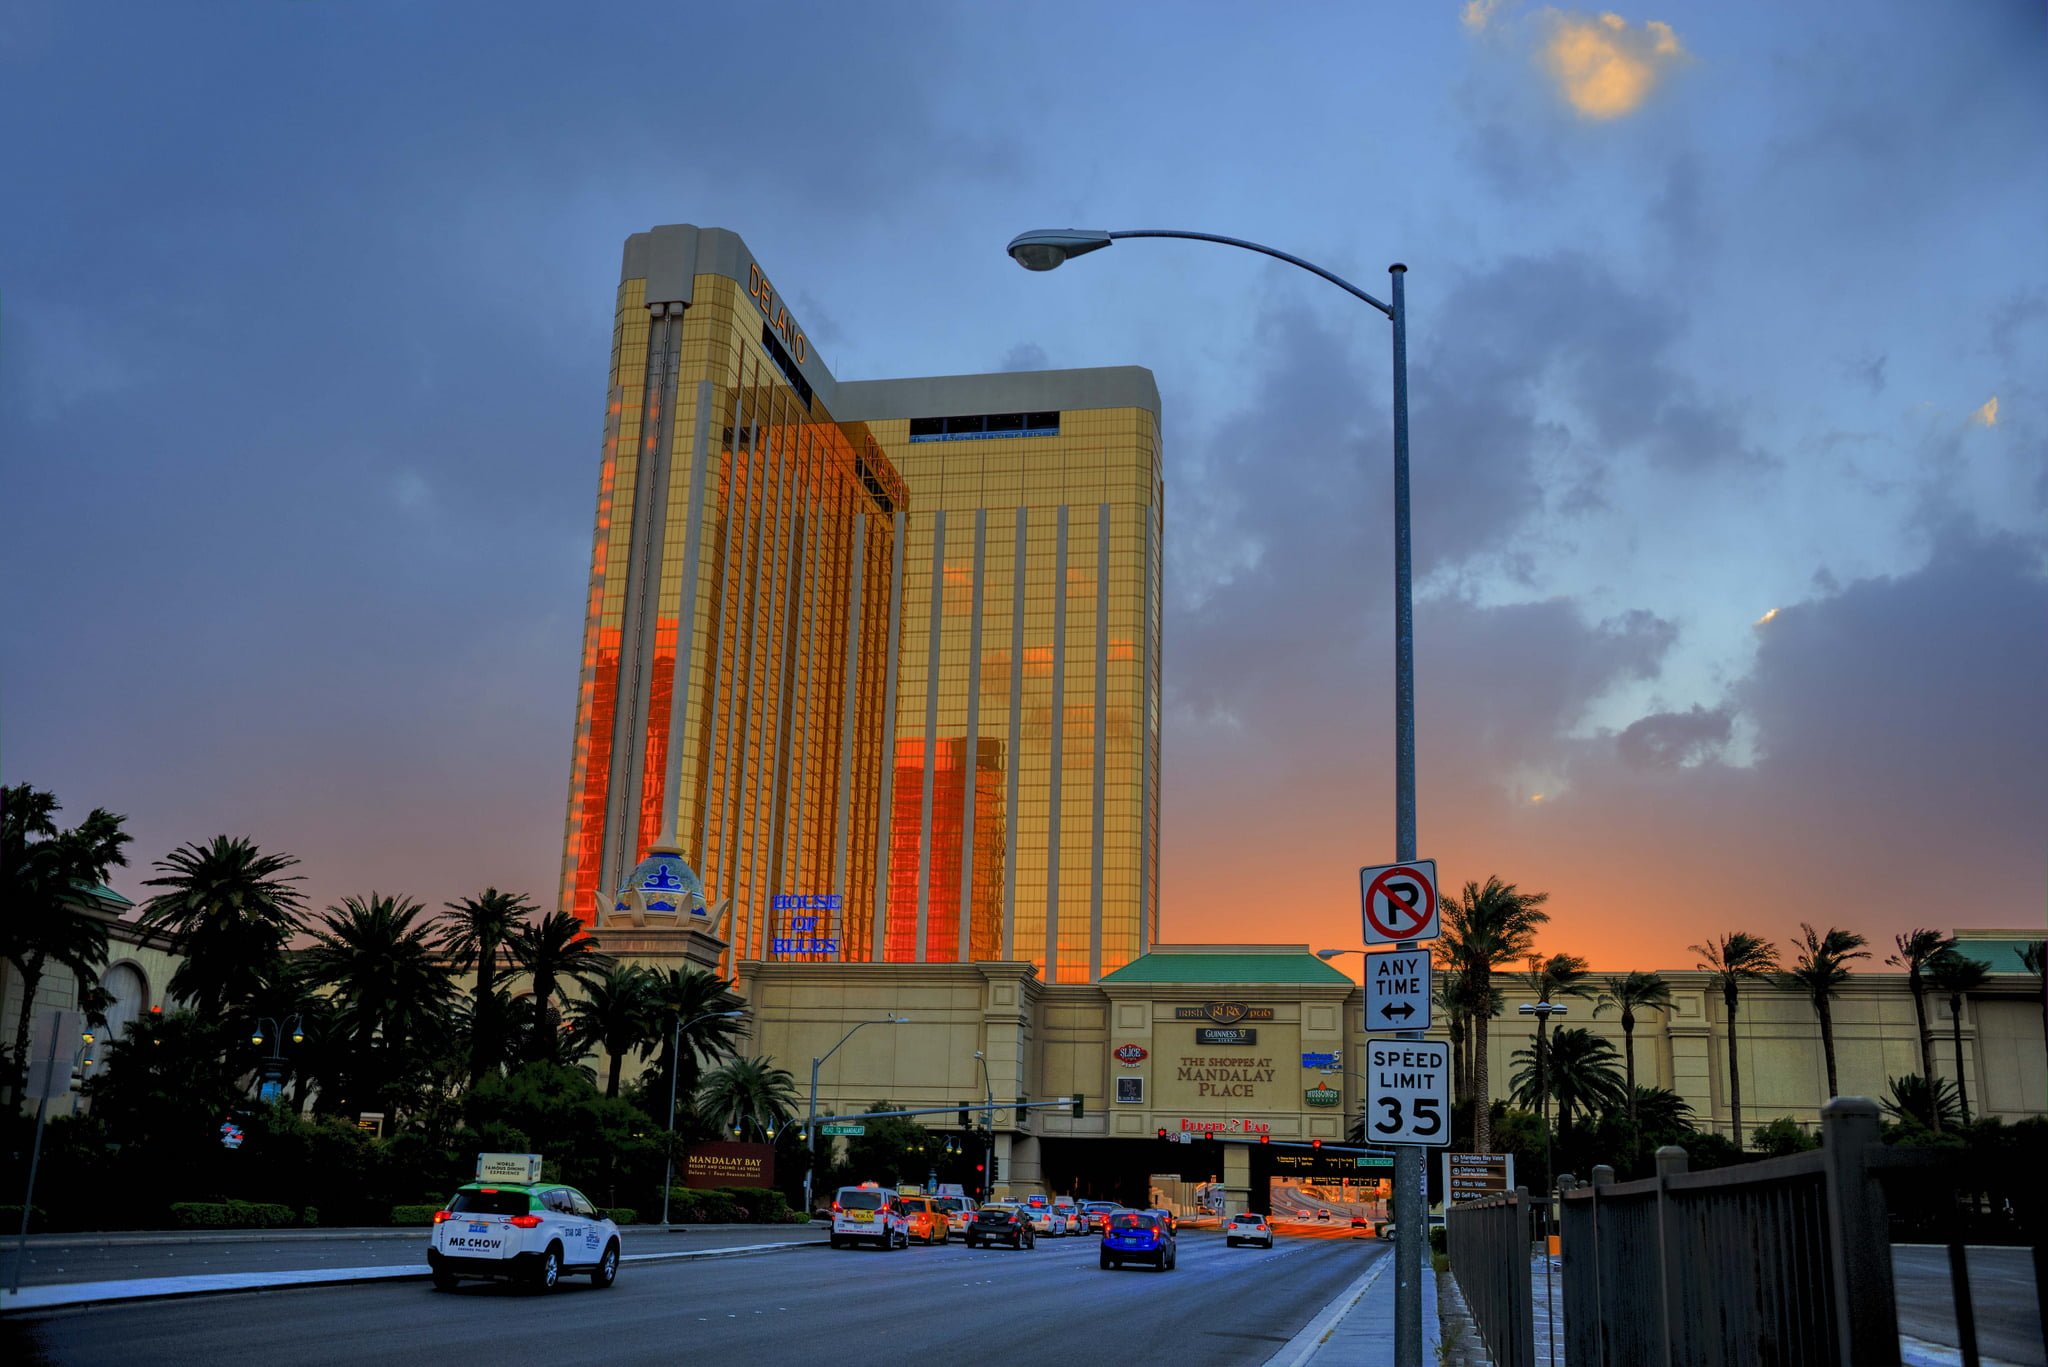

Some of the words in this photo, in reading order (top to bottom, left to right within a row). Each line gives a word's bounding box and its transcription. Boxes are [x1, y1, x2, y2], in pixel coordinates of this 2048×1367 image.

[749, 263, 807, 364] DELANO
[773, 894, 842, 910] HOUSE
[792, 916, 818, 932] OF
[773, 938, 837, 954] BLUES
[1378, 959, 1419, 977] ANY
[1376, 978, 1420, 996] TIME
[1205, 1029, 1238, 1039] GUINNESS
[1180, 1057, 1206, 1067] THE
[1208, 1057, 1255, 1068] SHOPPES
[1257, 1058, 1273, 1068] AT
[1373, 1051, 1442, 1068] SPEED
[1177, 1067, 1275, 1082] MANDALAY
[1380, 1072, 1435, 1090] LIMIT
[1198, 1082, 1254, 1097] PLACE
[1374, 1096, 1441, 1136] 35
[689, 1155, 743, 1165] MANDALAY
[745, 1158, 762, 1166] BAY
[449, 1237, 466, 1247] MR
[468, 1238, 502, 1249] CHOW
